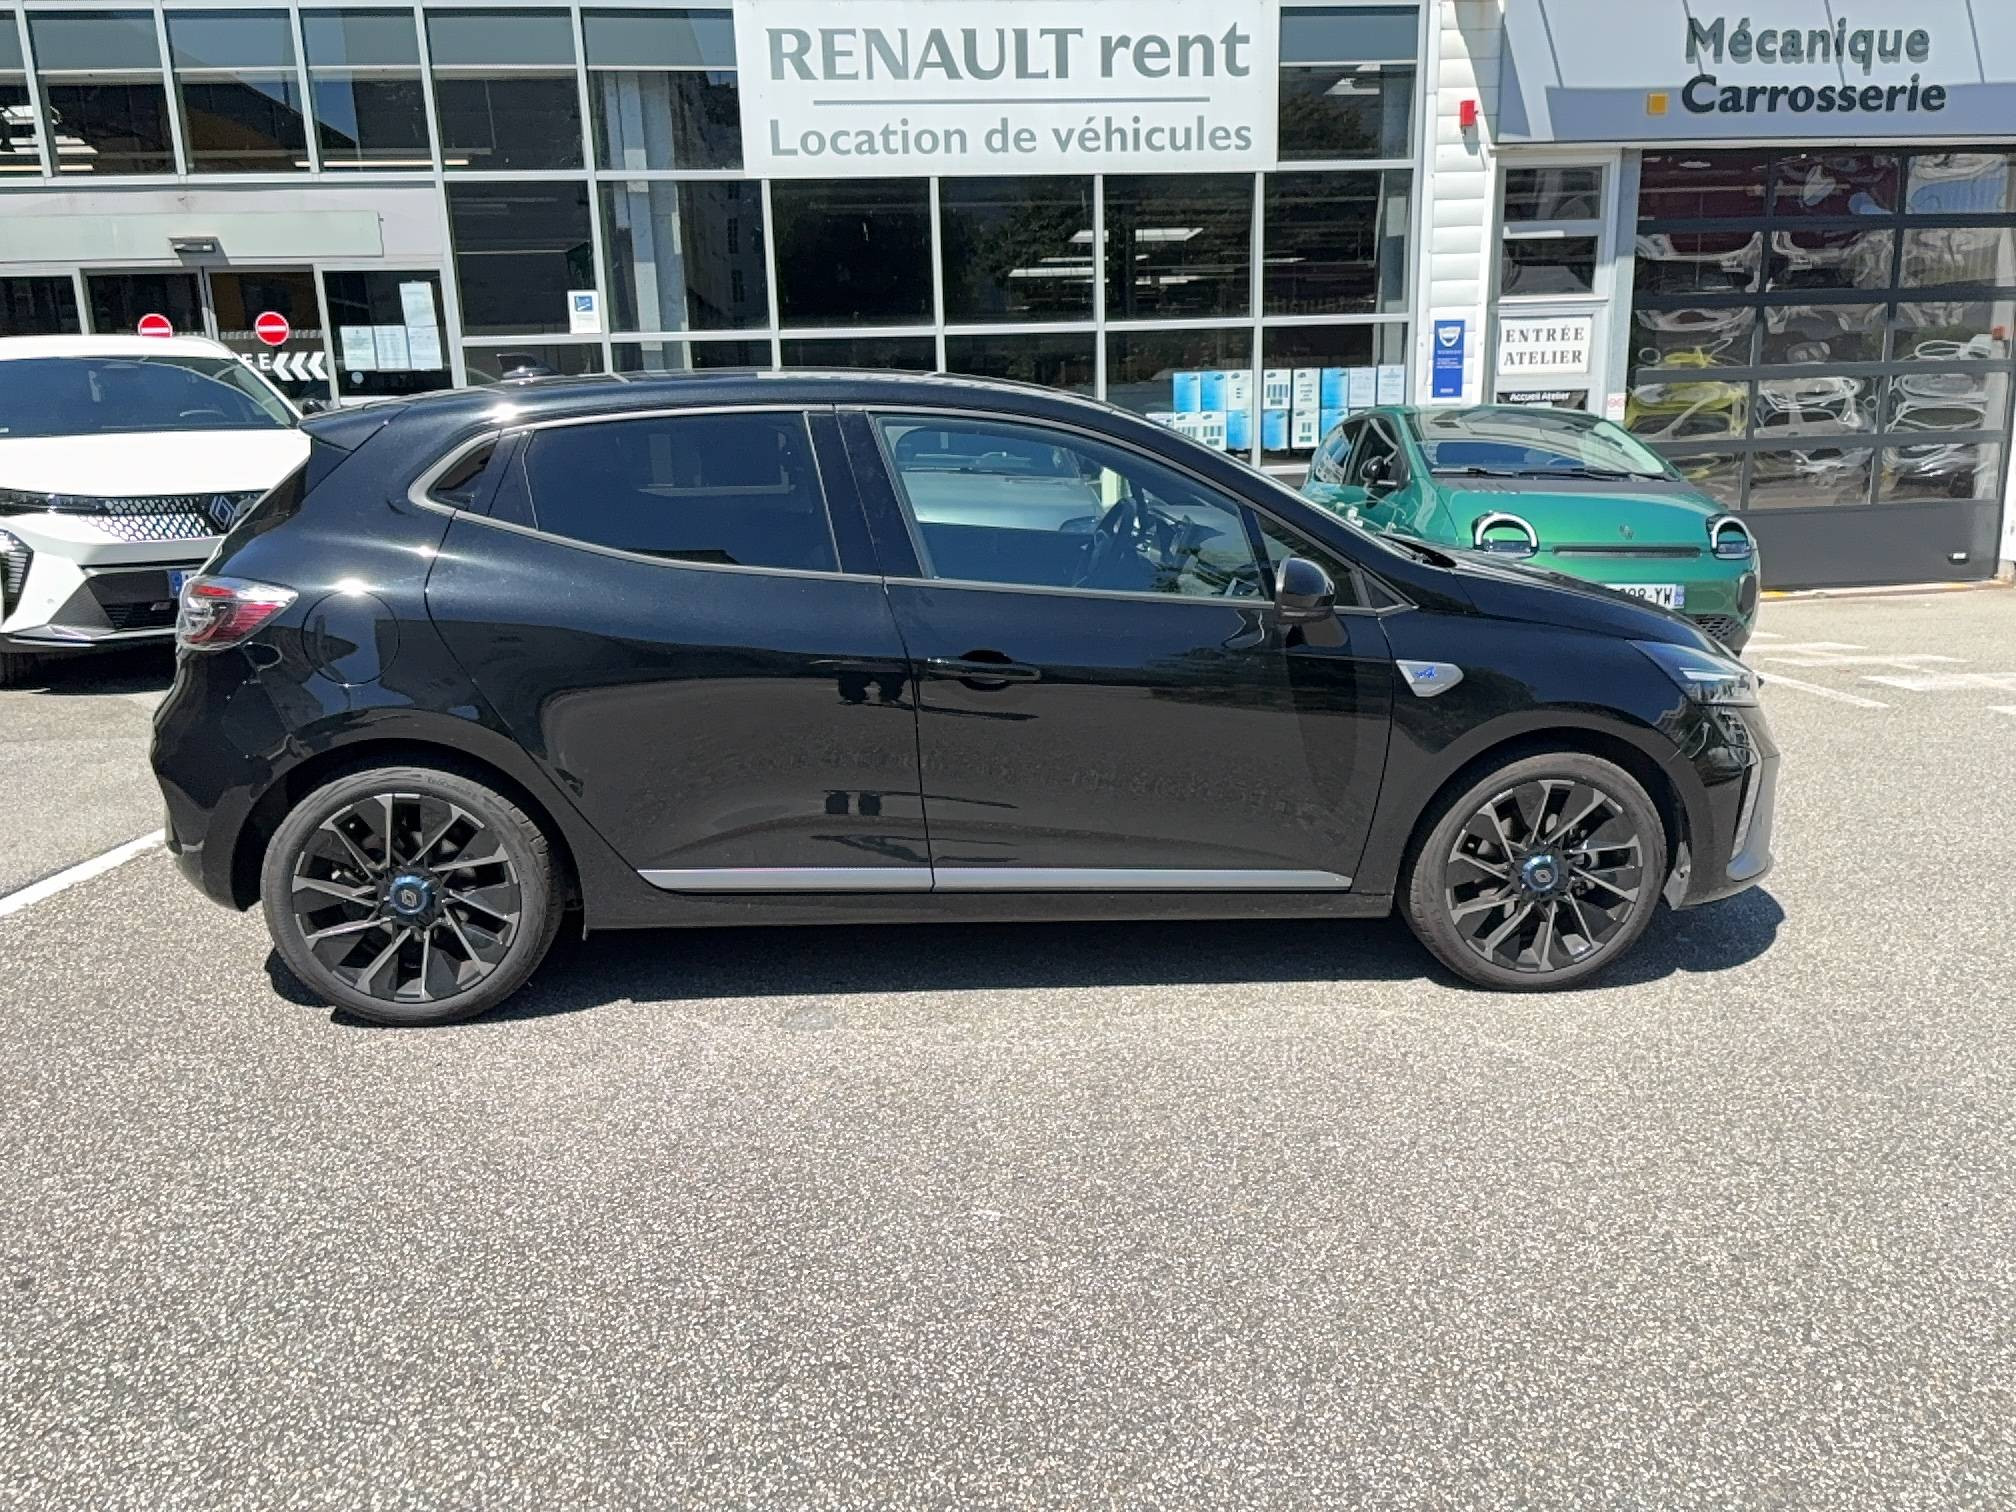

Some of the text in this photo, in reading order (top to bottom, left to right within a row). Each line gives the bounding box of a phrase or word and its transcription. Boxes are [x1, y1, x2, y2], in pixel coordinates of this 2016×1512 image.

[765, 22, 1250, 80] RENAULT rent
[1685, 17, 1930, 76] Mécanique
[1681, 73, 1946, 114] Carrosserie
[770, 115, 1252, 156] Location de véhicules
[1505, 324, 1584, 343] ENTRÉE
[1504, 350, 1582, 366] ATELIER
